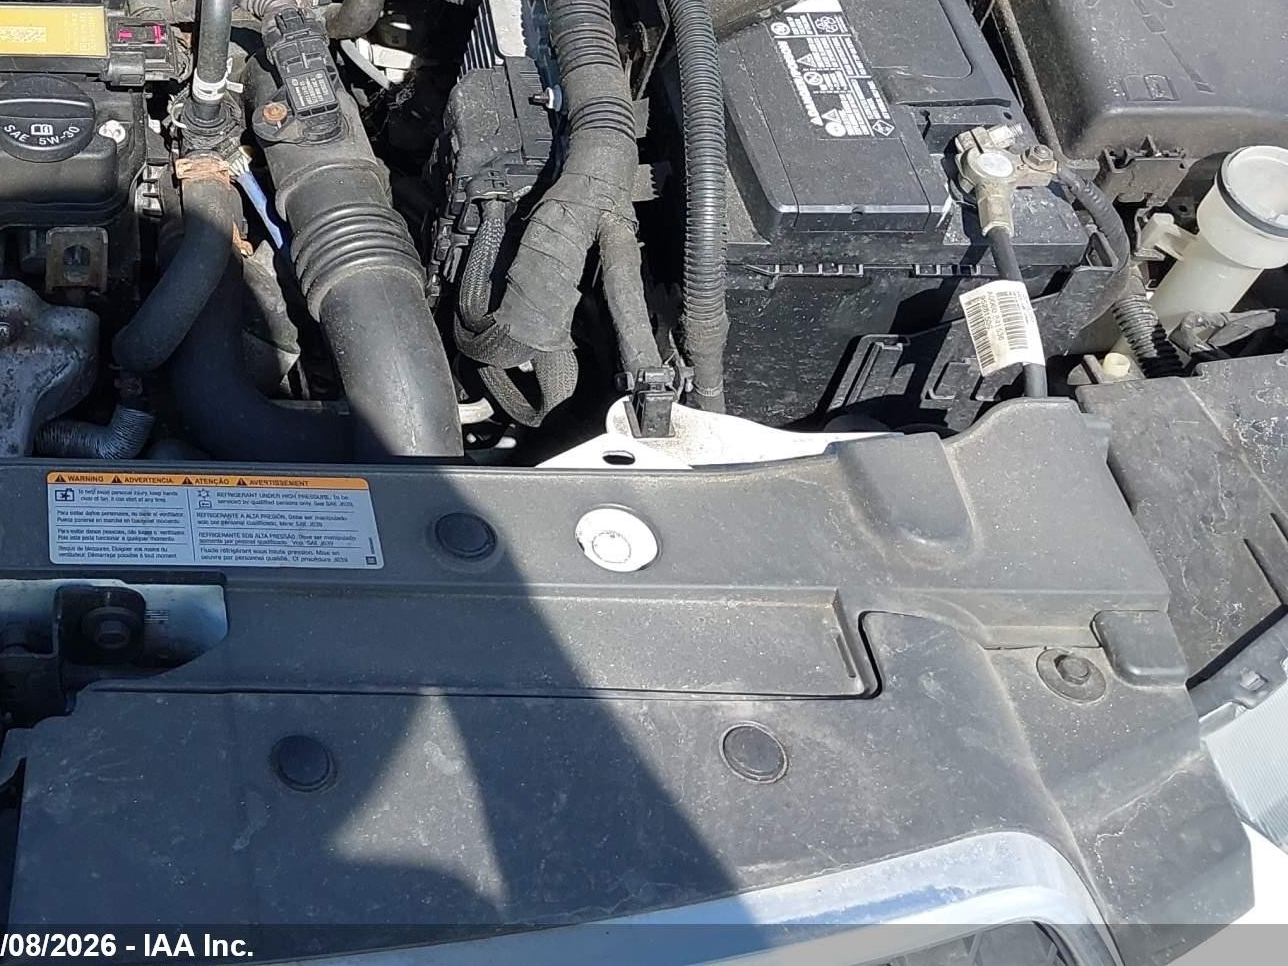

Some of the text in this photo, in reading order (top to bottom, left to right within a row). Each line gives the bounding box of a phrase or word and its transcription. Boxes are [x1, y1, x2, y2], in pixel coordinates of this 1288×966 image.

[3, 124, 81, 145] SAE 5W-30
[68, 475, 104, 483] WARNING
[195, 477, 230, 485] ATENÇÃO
